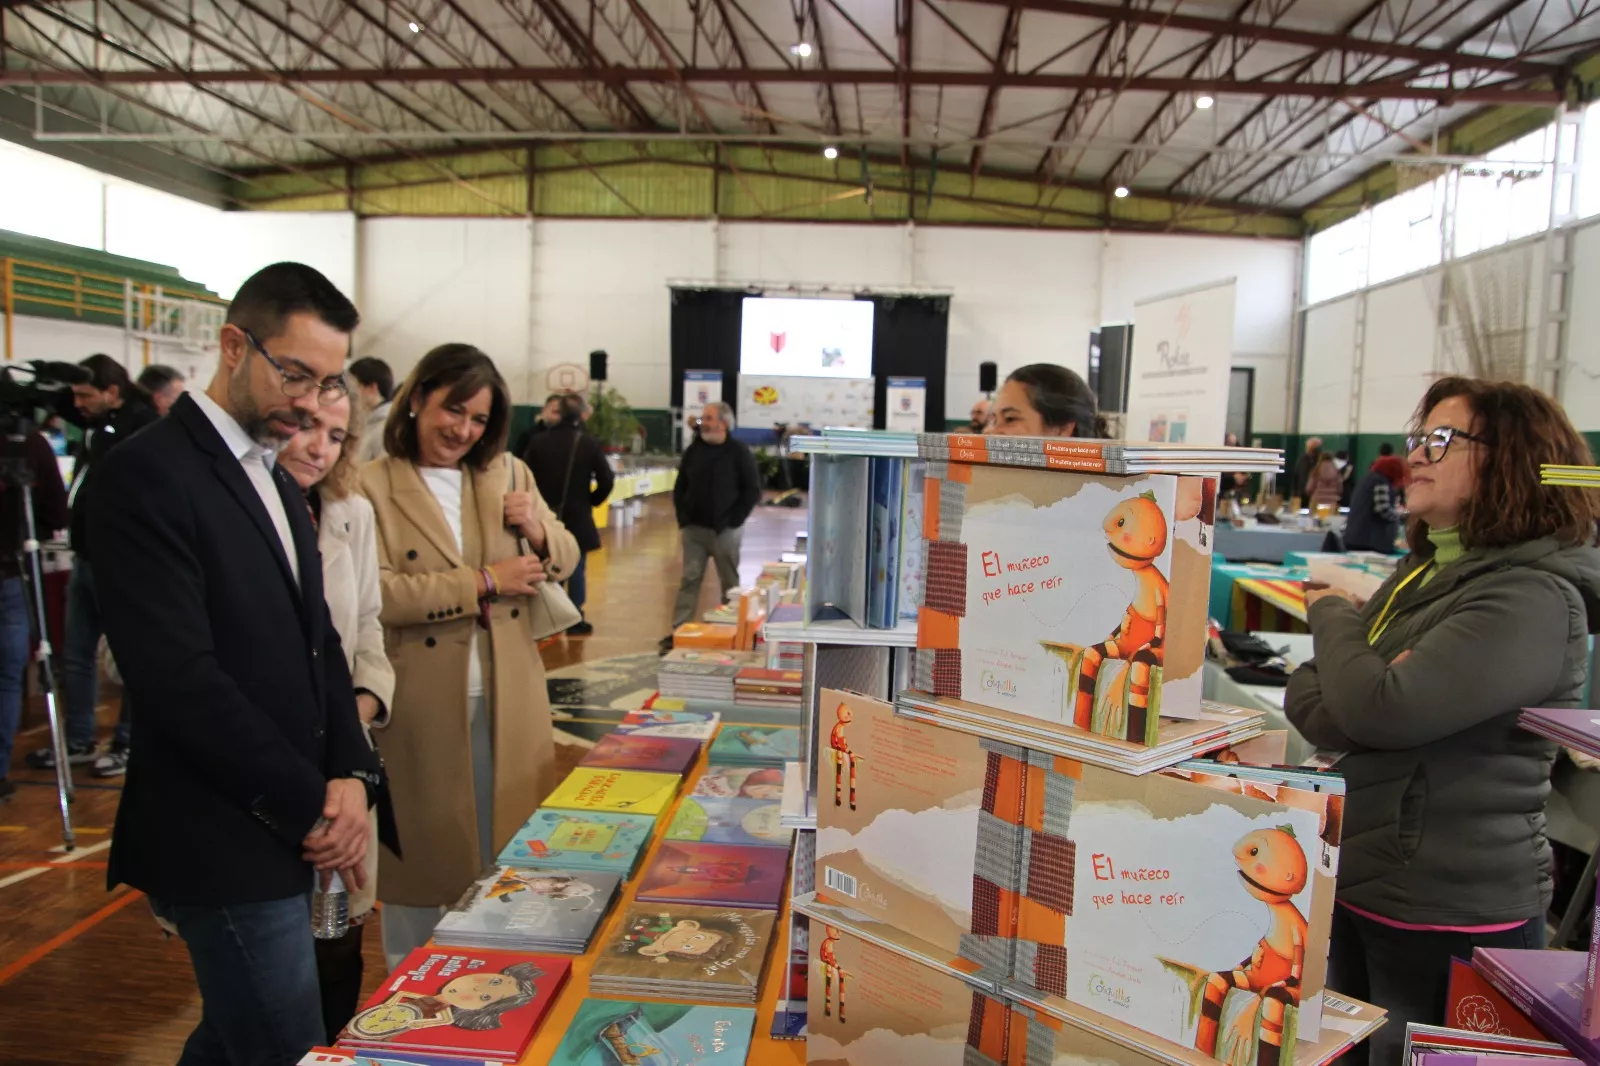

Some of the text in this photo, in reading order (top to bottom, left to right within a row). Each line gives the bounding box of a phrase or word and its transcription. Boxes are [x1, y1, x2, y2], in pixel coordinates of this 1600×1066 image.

[981, 551, 1050, 578] El muñeco
[981, 575, 1064, 606] que hace reír
[1091, 853, 1170, 883] El muñeco
[1092, 891, 1185, 910] que hace reír
